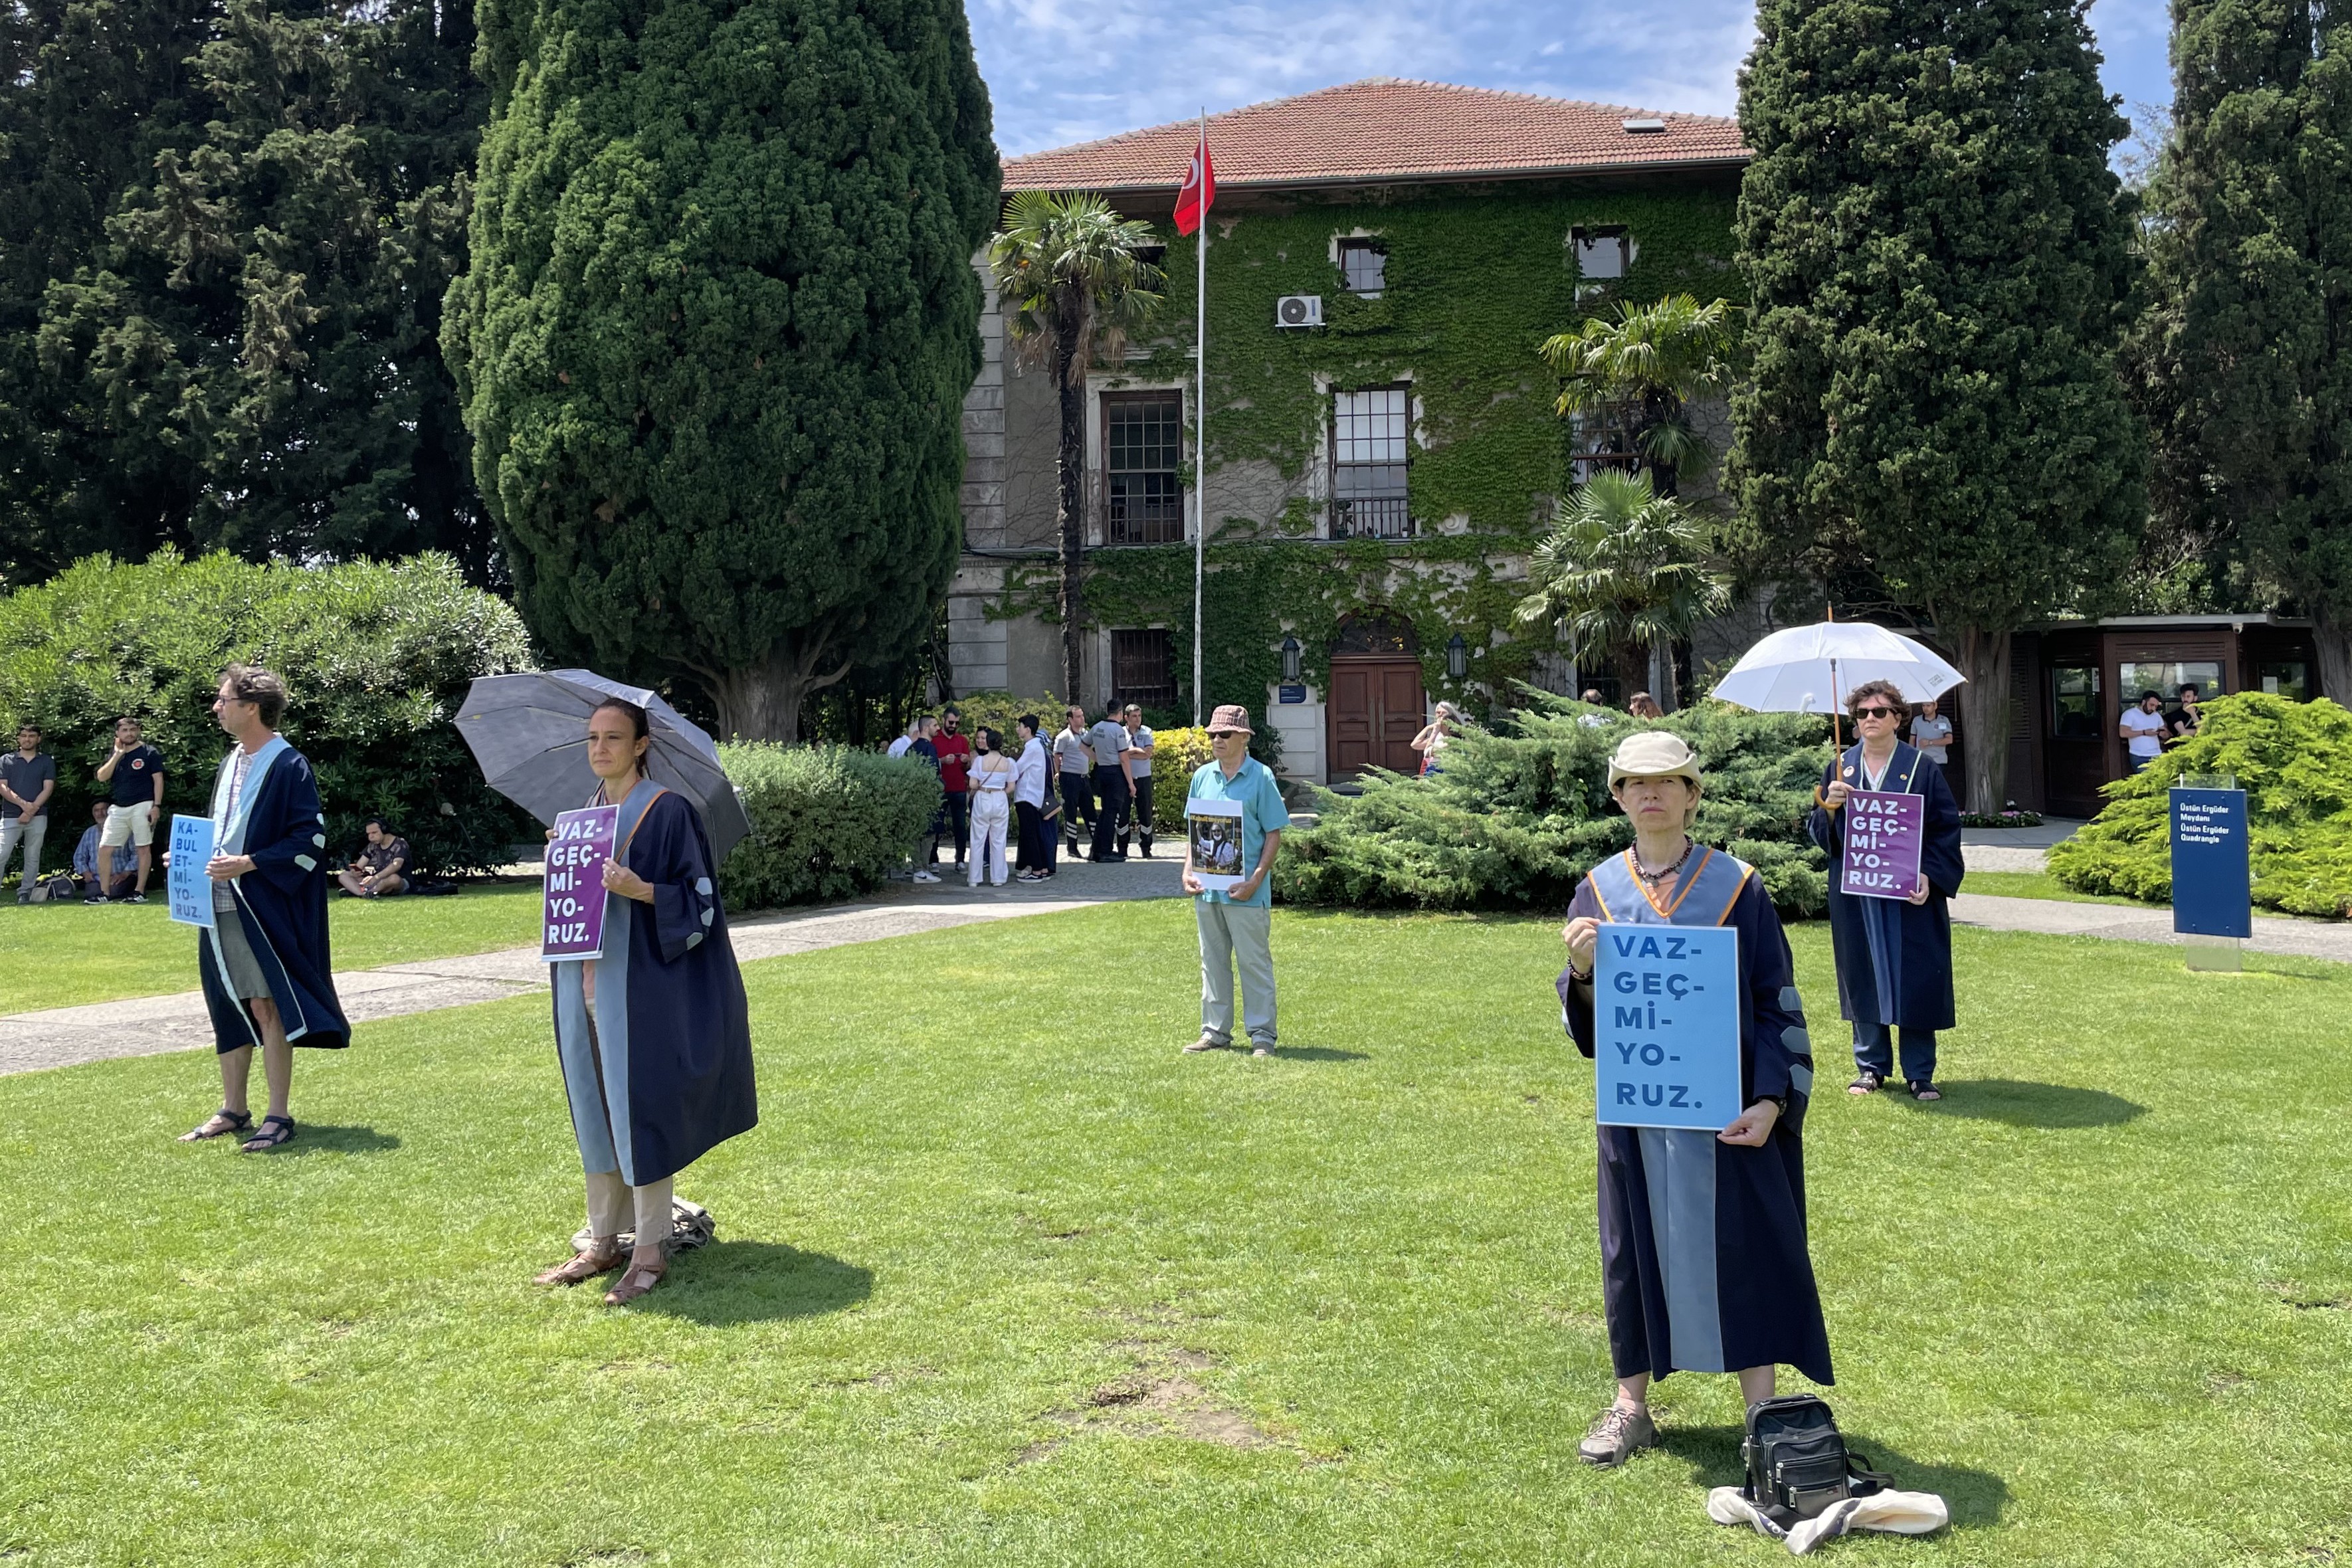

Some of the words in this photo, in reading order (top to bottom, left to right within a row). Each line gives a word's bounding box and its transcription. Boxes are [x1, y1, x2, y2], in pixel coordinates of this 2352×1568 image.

[1852, 797, 1908, 815] VAZ-
[2180, 802, 2201, 812] Üstün
[2202, 805, 2229, 814] Ergüder
[1852, 816, 1908, 836] GEÇ-
[2180, 813, 2210, 823] Meydanı
[177, 821, 198, 835] KA-
[558, 819, 603, 841] VAZ-
[2181, 823, 2201, 833] Üstün
[2203, 825, 2229, 834] Ergüder
[176, 838, 197, 852] BUL
[1850, 832, 1886, 850] Mİ-
[2181, 833, 2220, 844] Quadrangle
[174, 854, 192, 868] ET-
[551, 844, 601, 868] GEÇ-
[1850, 852, 1890, 868] YO-
[174, 869, 192, 884] Mİ-
[549, 866, 582, 892] Mİ-
[1848, 870, 1902, 890] RUZ.
[174, 887, 195, 900] YO-
[175, 904, 203, 919] RUZ.
[549, 898, 584, 918] YO-
[547, 922, 589, 944] RUZ.
[1612, 935, 1702, 960] VAZ-
[1613, 971, 1704, 1001] GEÇ-
[1615, 1000, 1672, 1030] Mİ-
[1615, 1042, 1681, 1066] YO-
[1617, 1082, 1702, 1109] RUZ.
